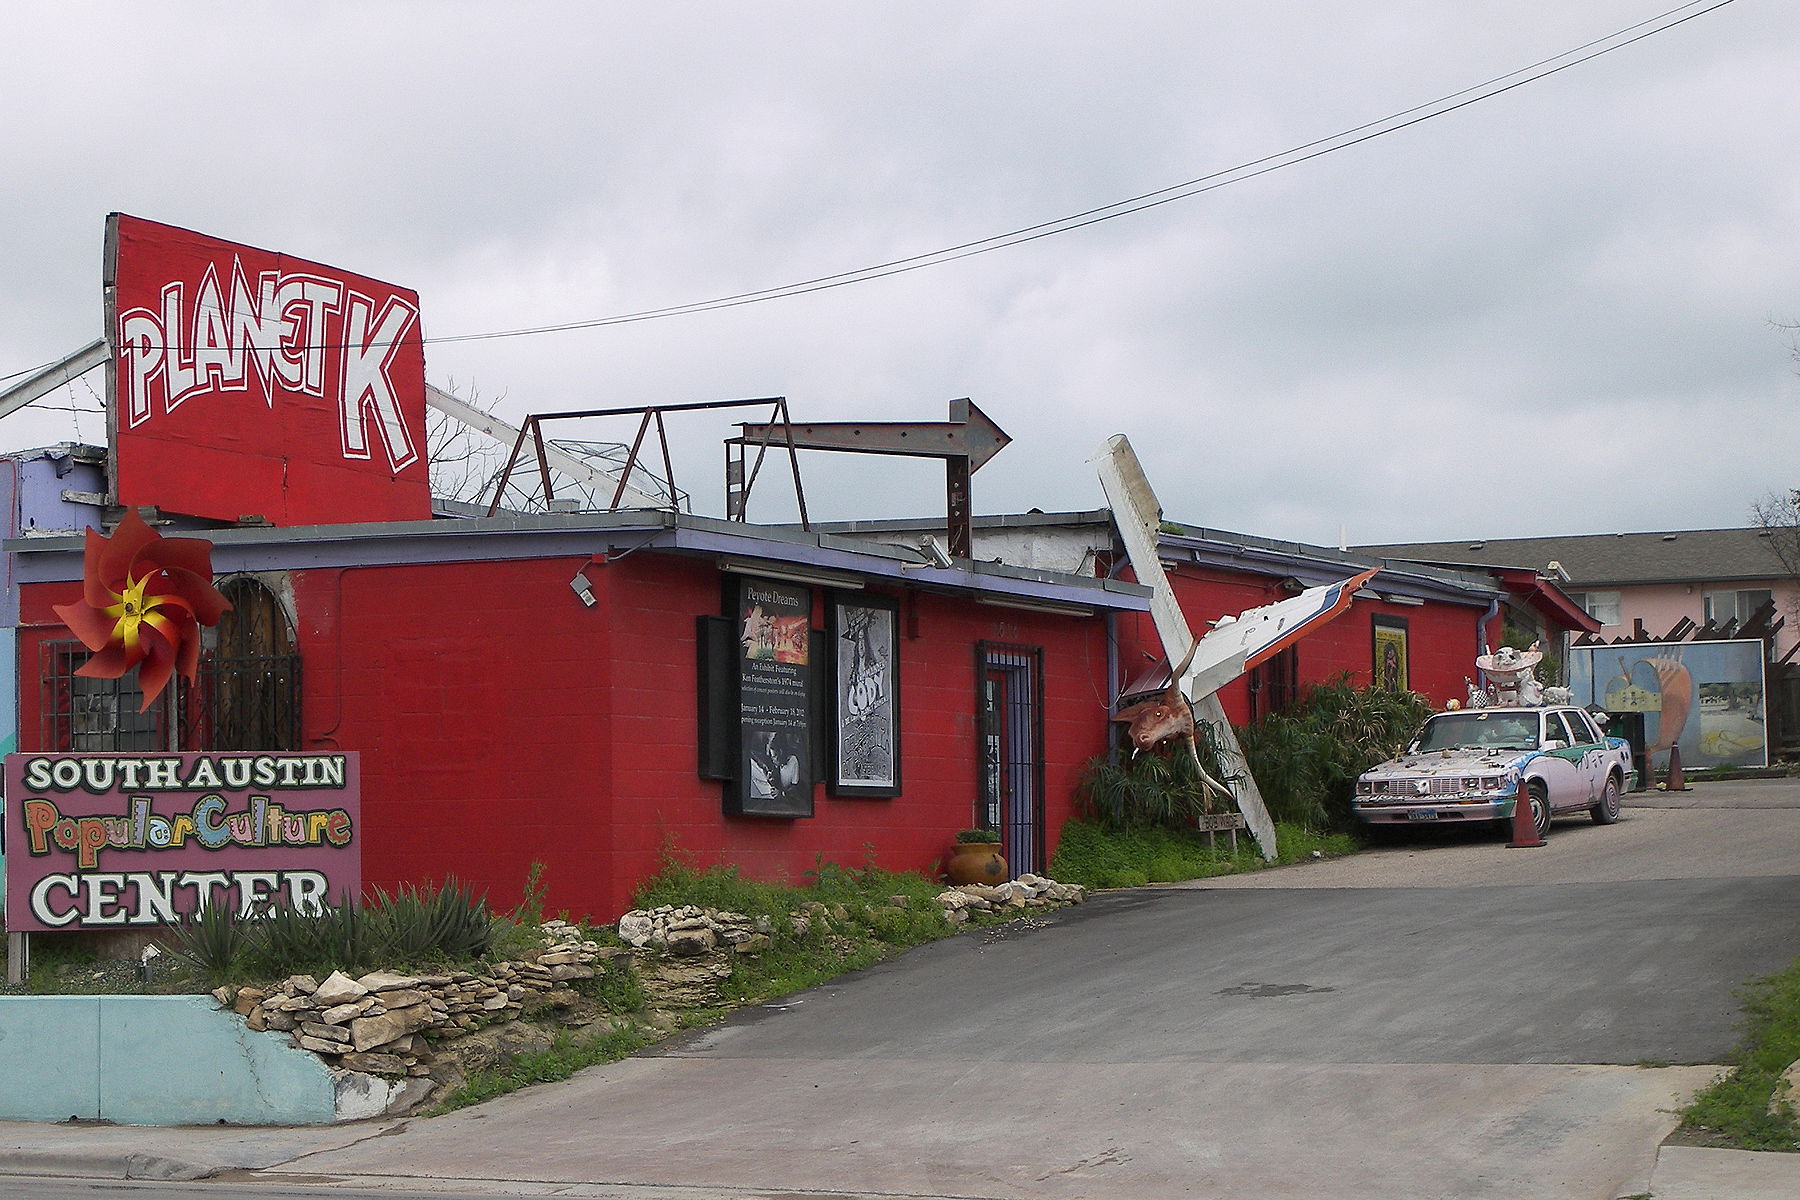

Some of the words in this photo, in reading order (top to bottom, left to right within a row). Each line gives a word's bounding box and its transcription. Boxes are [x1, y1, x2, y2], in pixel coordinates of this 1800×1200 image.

[120, 252, 343, 429] PLANET
[337, 289, 419, 473] K
[747, 587, 771, 605] Peyote
[772, 591, 799, 607] Dreams
[752, 662, 759, 670] An
[760, 663, 775, 672] Exhibit
[775, 665, 797, 676] Featuring
[741, 703, 758, 714] January
[769, 706, 789, 717] February
[848, 671, 884, 715] CODY
[26, 757, 183, 792] SOUTH
[186, 755, 345, 790] AUSTIN
[23, 795, 194, 870] Popular
[193, 794, 352, 849] Culture
[29, 871, 332, 928] CENTER
